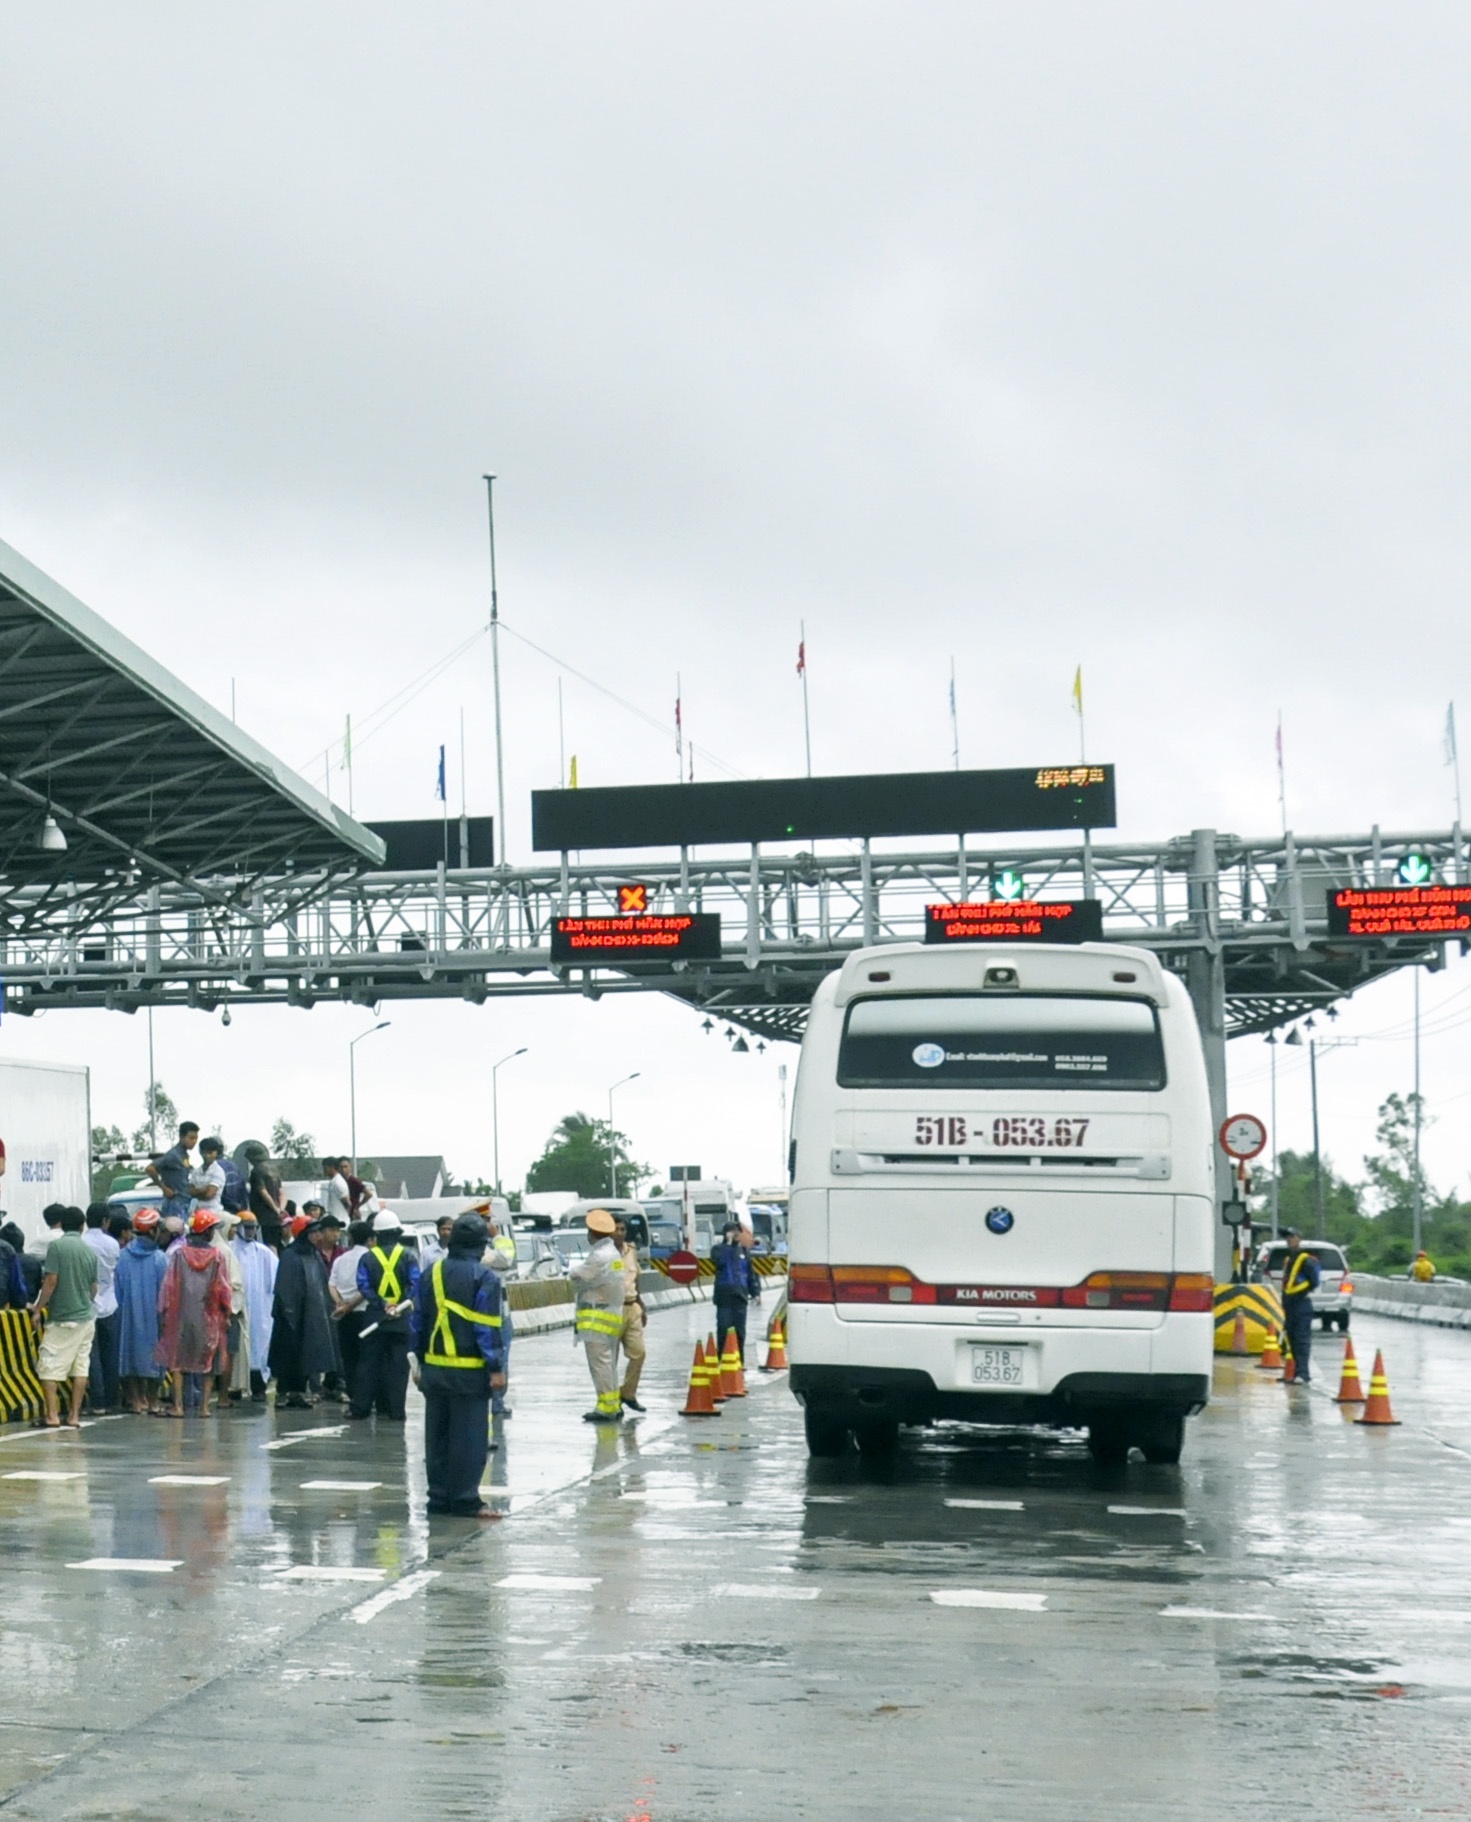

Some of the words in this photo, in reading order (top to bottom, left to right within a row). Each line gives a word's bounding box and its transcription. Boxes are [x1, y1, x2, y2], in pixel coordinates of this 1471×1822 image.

[915, 1117, 967, 1146] 51B
[992, 1117, 1090, 1147] 053.67
[956, 1288, 979, 1299] KIA
[982, 1289, 1037, 1301] MOTORS
[984, 1350, 1011, 1366] 51B
